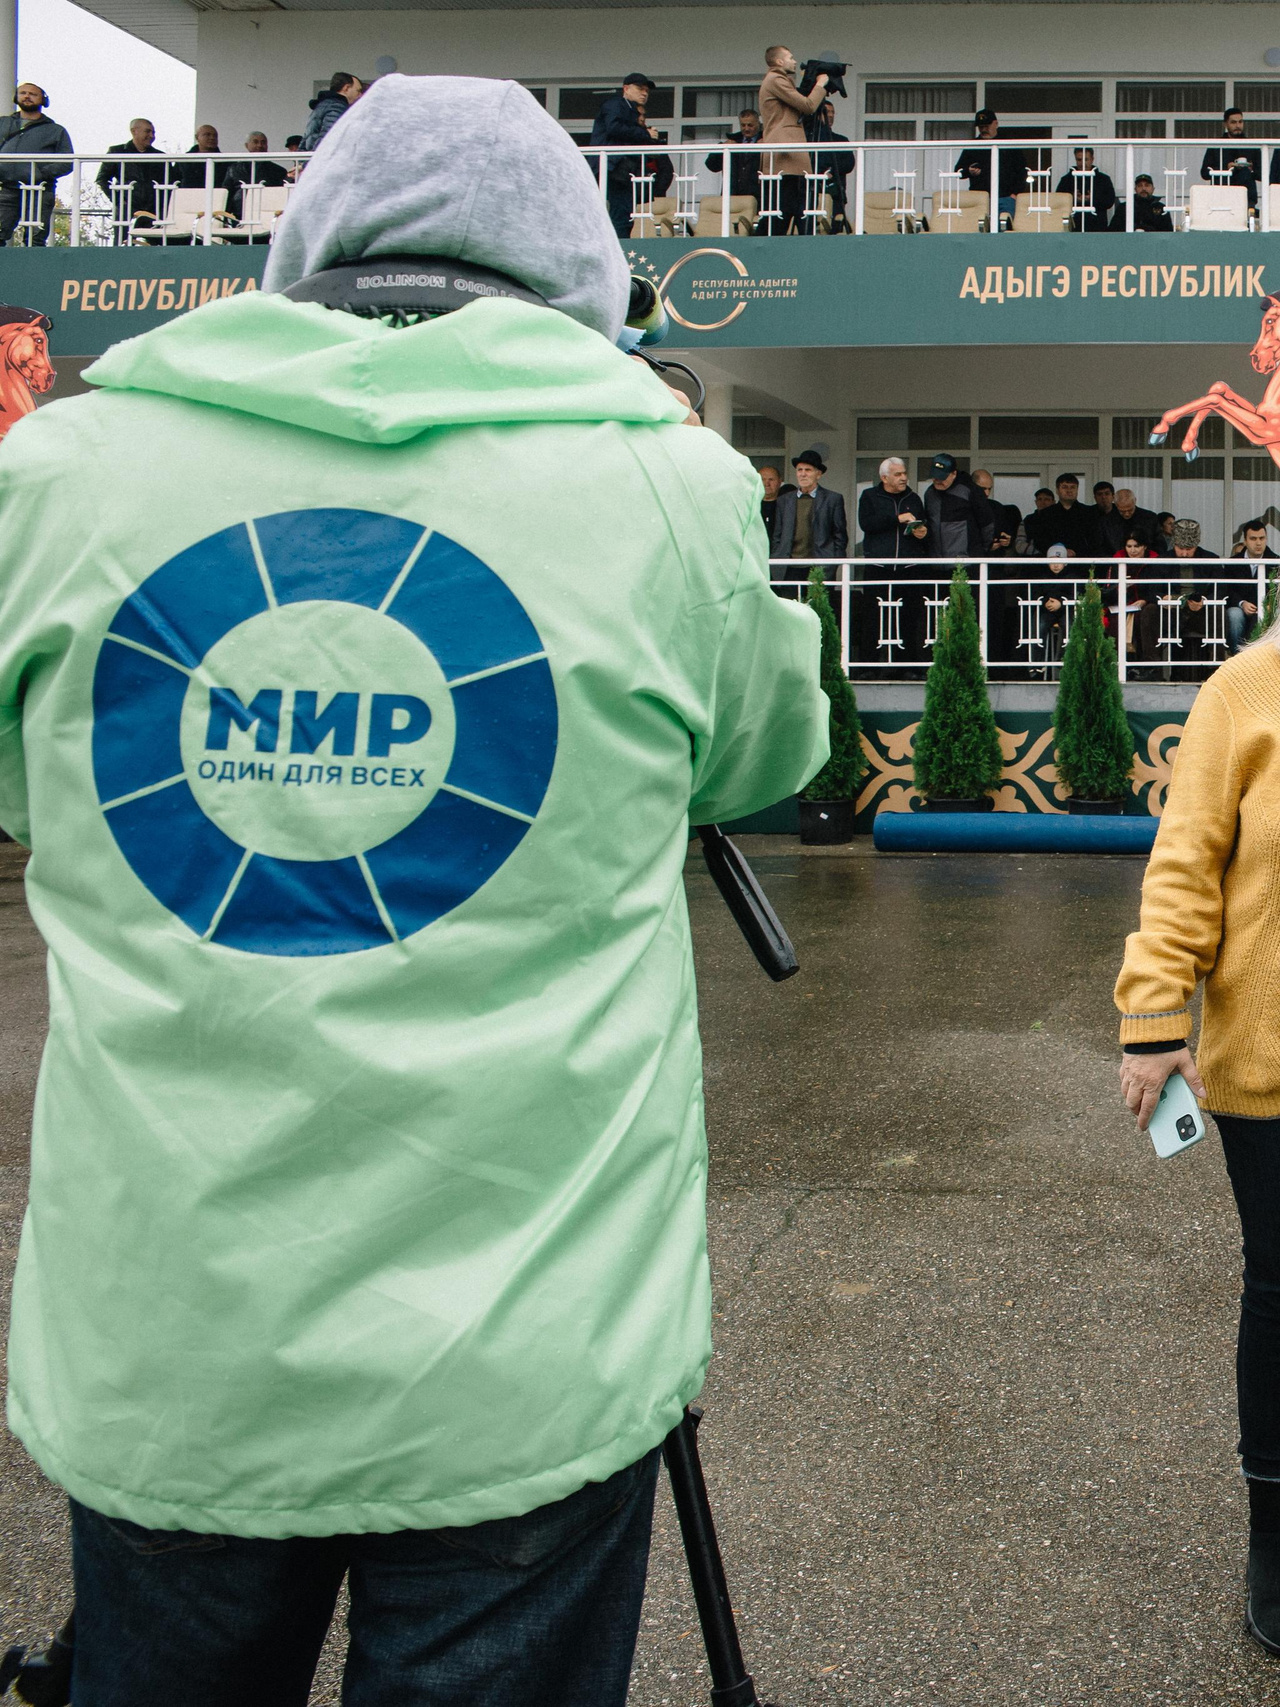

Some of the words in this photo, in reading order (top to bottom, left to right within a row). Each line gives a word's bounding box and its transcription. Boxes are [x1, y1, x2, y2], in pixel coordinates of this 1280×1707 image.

[356, 274, 447, 289] MONITOR
[692, 279, 756, 288] РЕСПУБЛИКА
[759, 278, 798, 288] АДЫГЕЯ
[959, 265, 1071, 304] АДЫГЭ
[1080, 264, 1266, 298] РЕСПУБЛИК
[691, 291, 728, 300] АДЫГЭ
[732, 289, 797, 299] РЕСПУБЛИК
[204, 686, 432, 757] МИР
[198, 760, 275, 783] ОДИН
[282, 763, 343, 787] ДЛЯ
[350, 766, 426, 788] ВСЕХ
